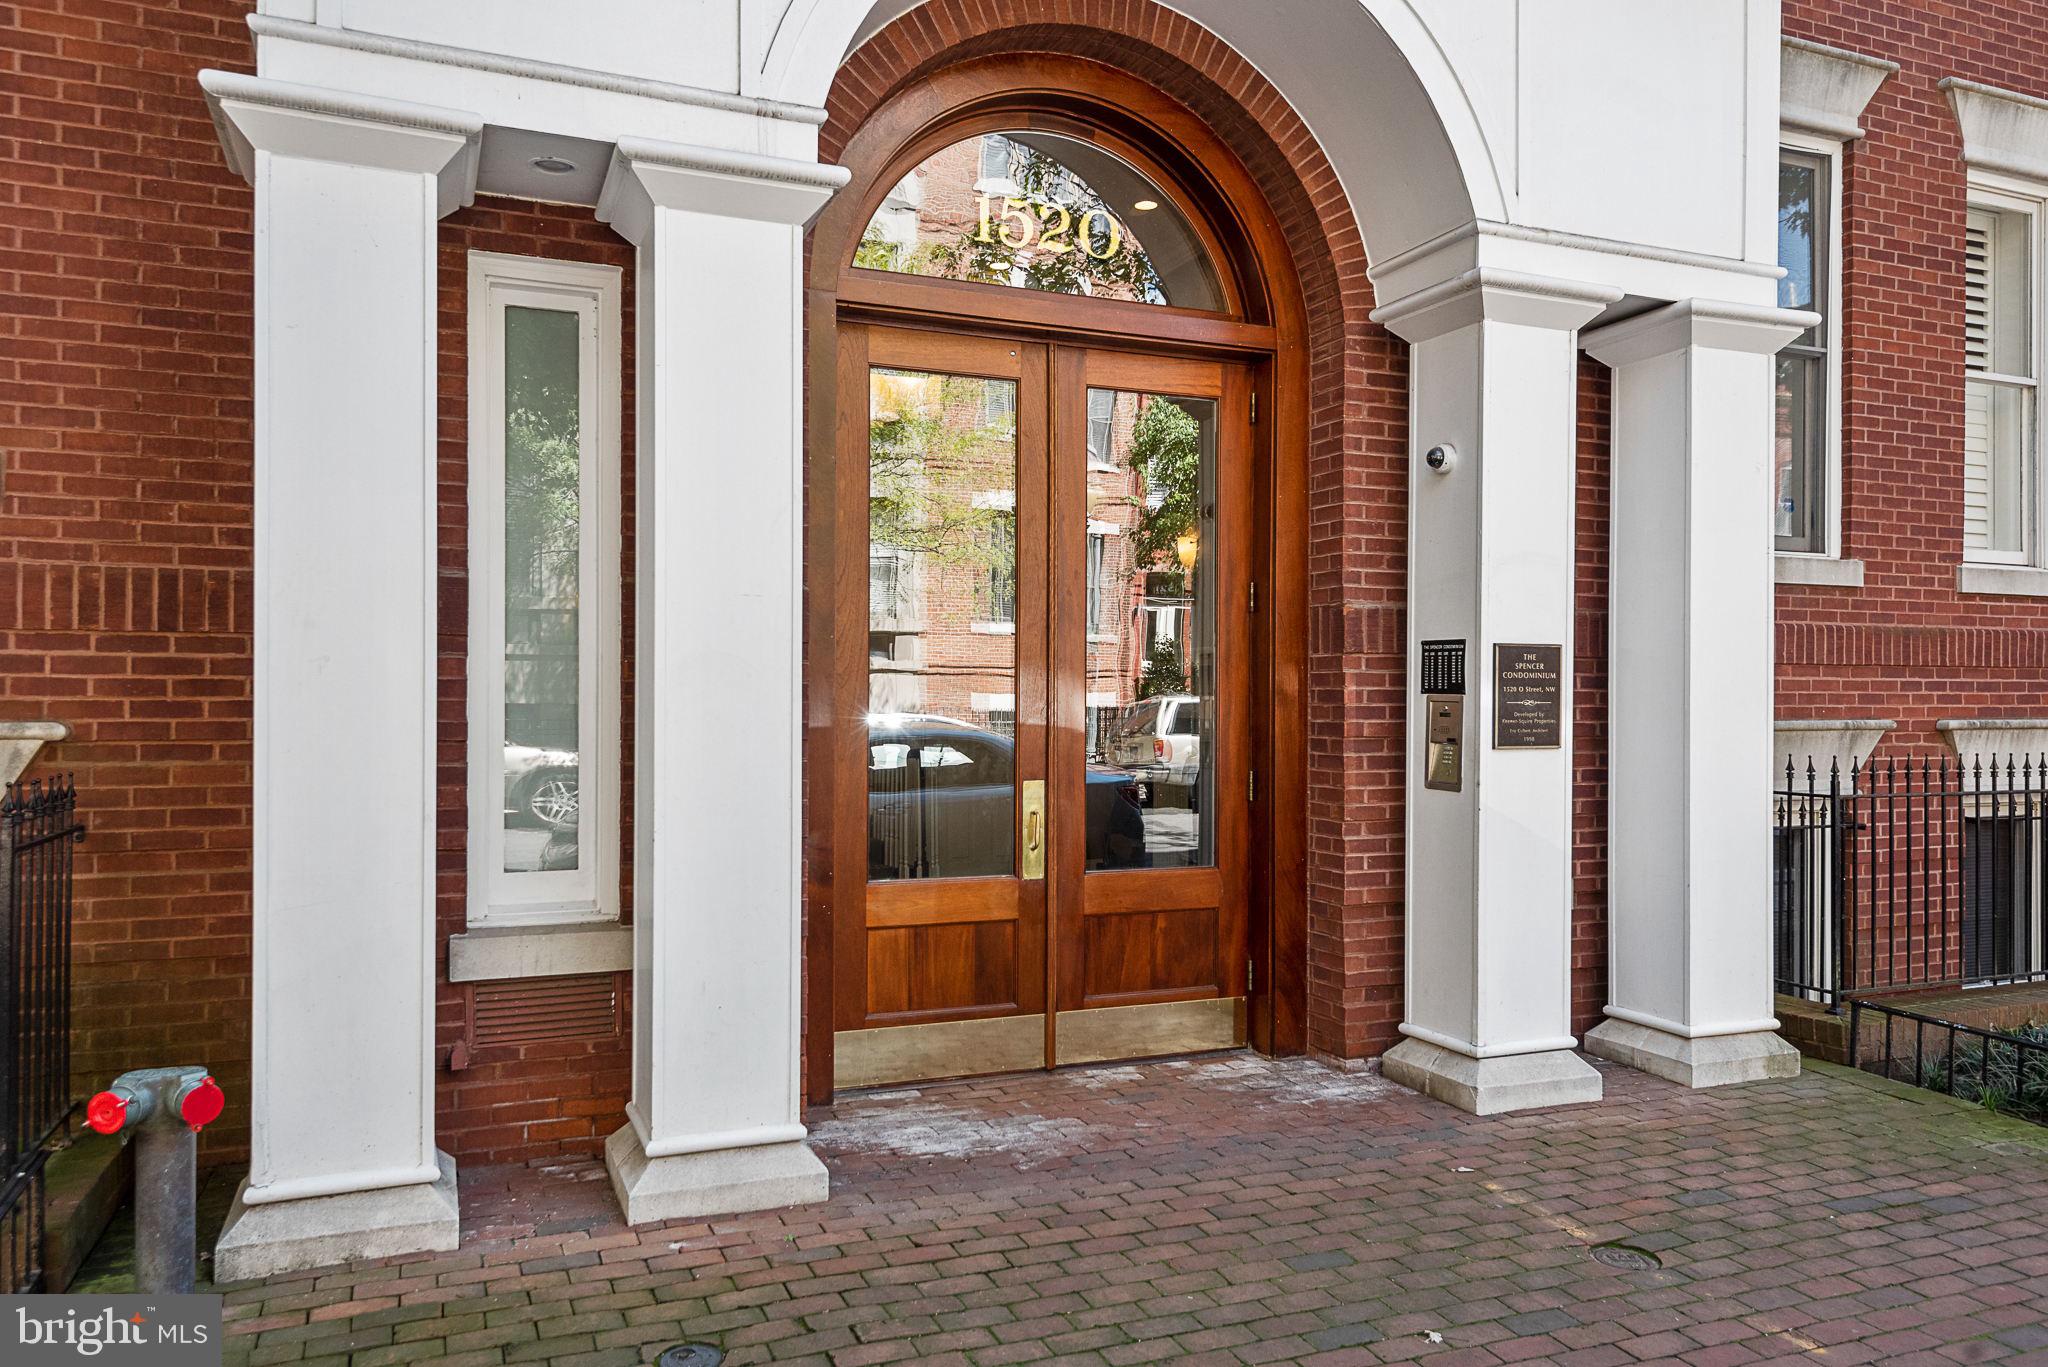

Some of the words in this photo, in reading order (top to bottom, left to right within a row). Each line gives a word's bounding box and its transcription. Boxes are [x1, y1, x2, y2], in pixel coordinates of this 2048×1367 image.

[974, 193, 1121, 259] 1520
[1523, 653, 1537, 661] THE
[1515, 662, 1544, 670] SPENCER
[1502, 671, 1556, 679] CONDOMINIUM
